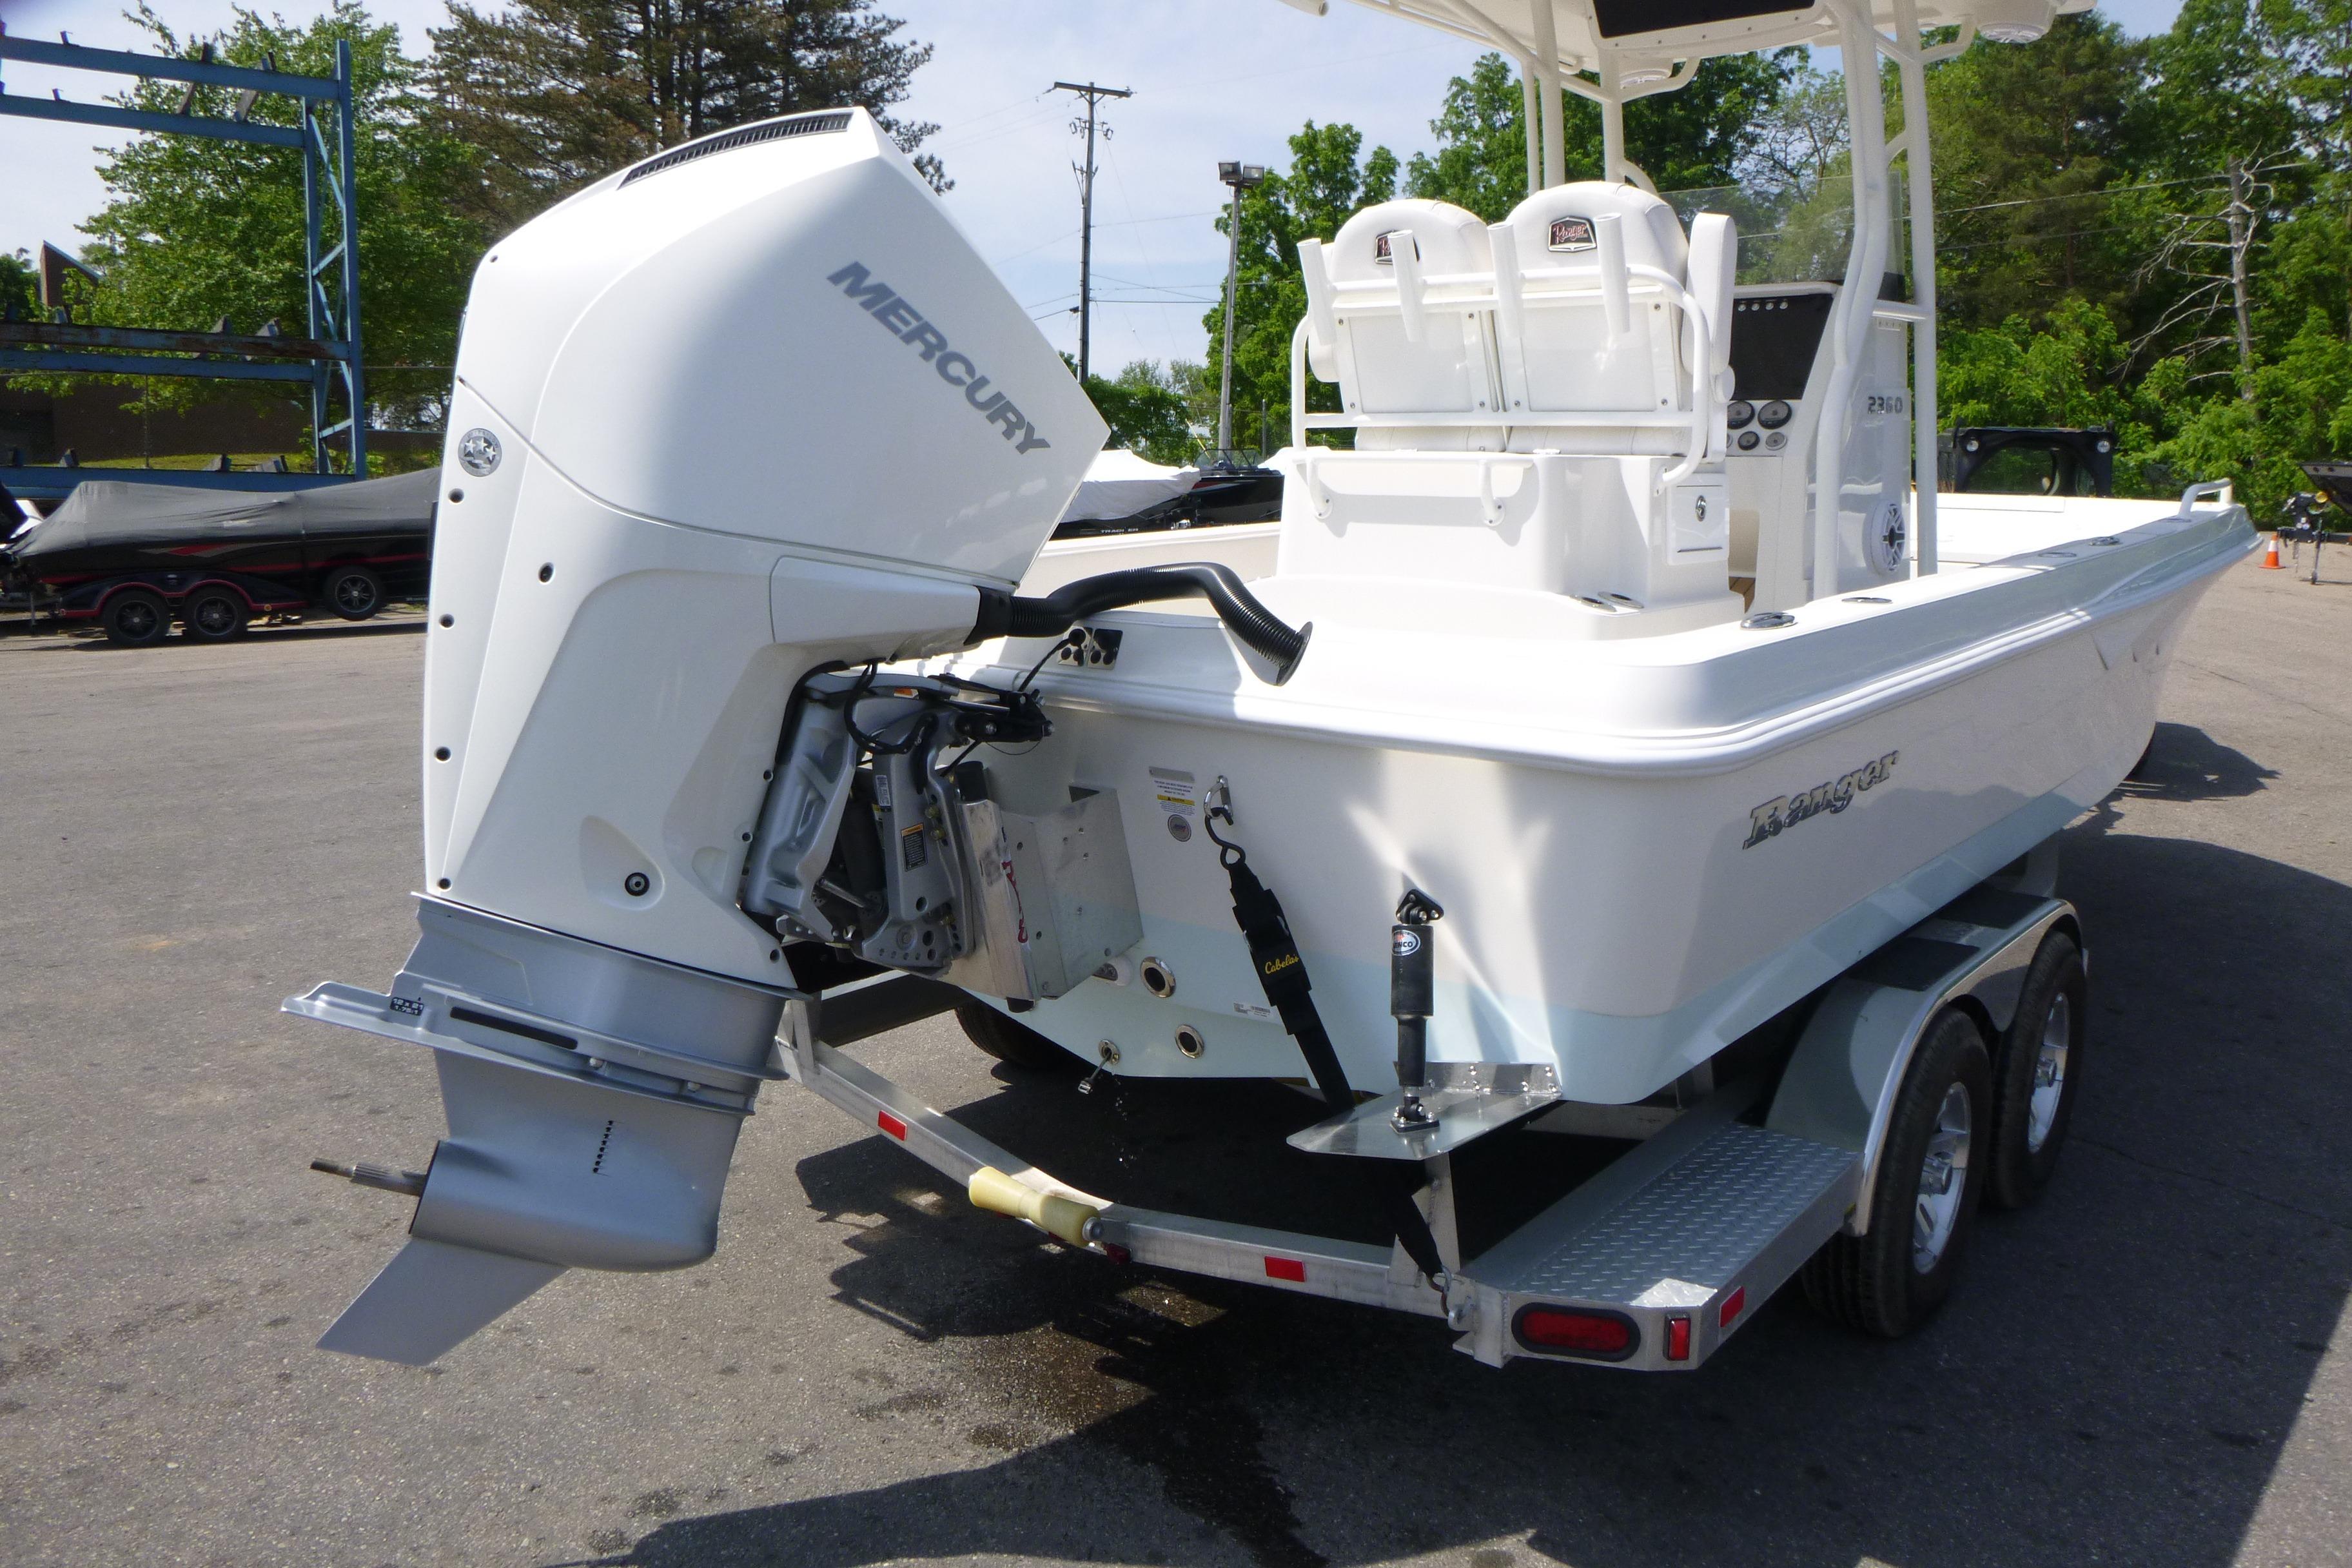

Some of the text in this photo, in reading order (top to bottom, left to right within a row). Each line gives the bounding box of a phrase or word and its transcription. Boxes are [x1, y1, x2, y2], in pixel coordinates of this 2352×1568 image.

[827, 261, 1051, 455] MERCURY
[1742, 750, 1900, 850] Ranger
[1265, 954, 1299, 974] Cabela's
[411, 1003, 424, 1011] 21
